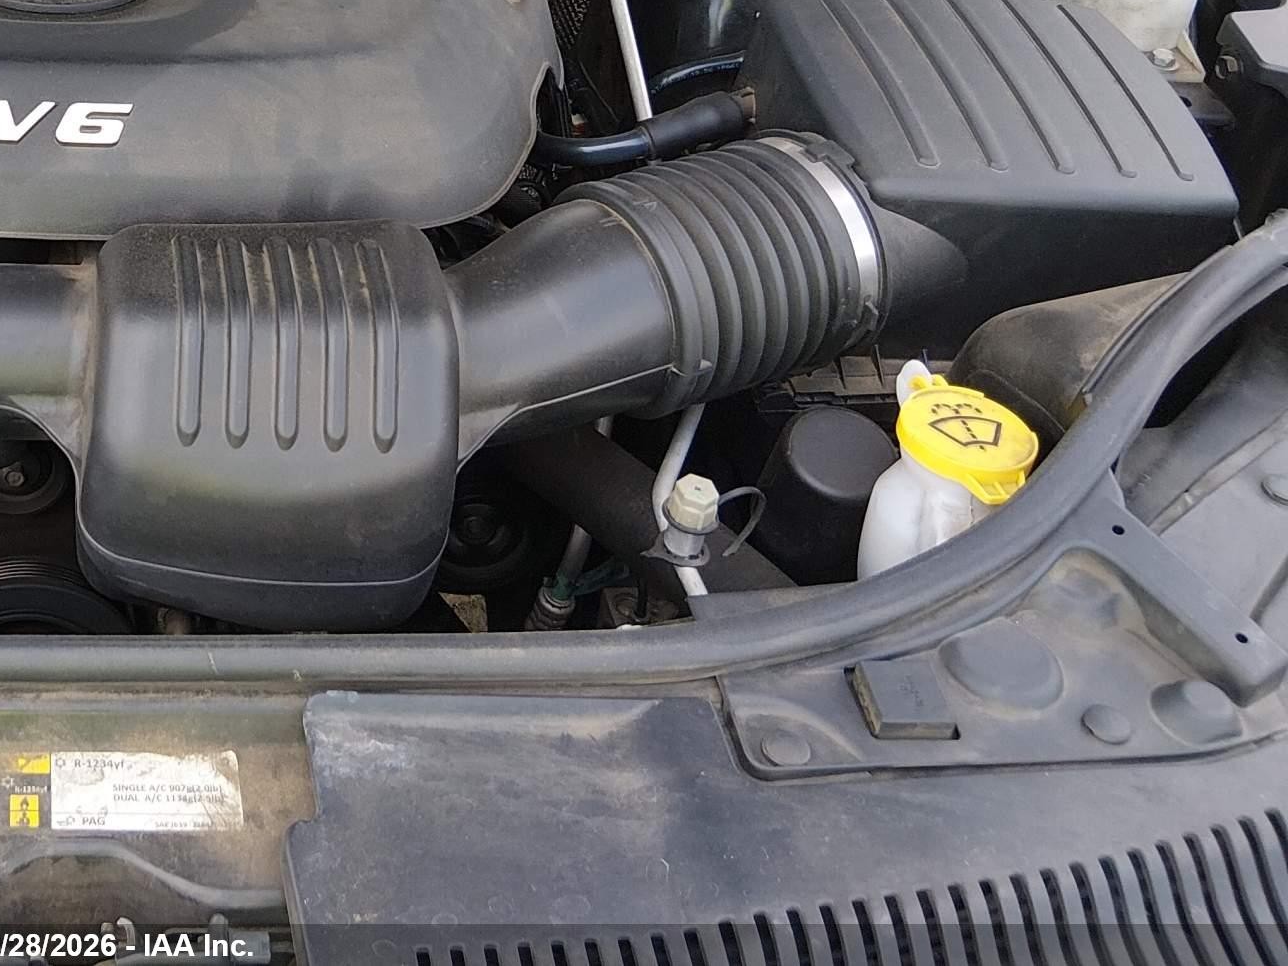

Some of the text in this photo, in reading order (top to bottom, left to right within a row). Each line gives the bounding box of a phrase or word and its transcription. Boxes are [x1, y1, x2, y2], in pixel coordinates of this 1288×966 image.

[73, 757, 125, 770] R-1234yf
[112, 783, 146, 792] SINGLE
[148, 783, 167, 793] A/C
[112, 793, 139, 802] DUAL
[144, 793, 163, 803] A/C
[82, 817, 106, 826] PAG
